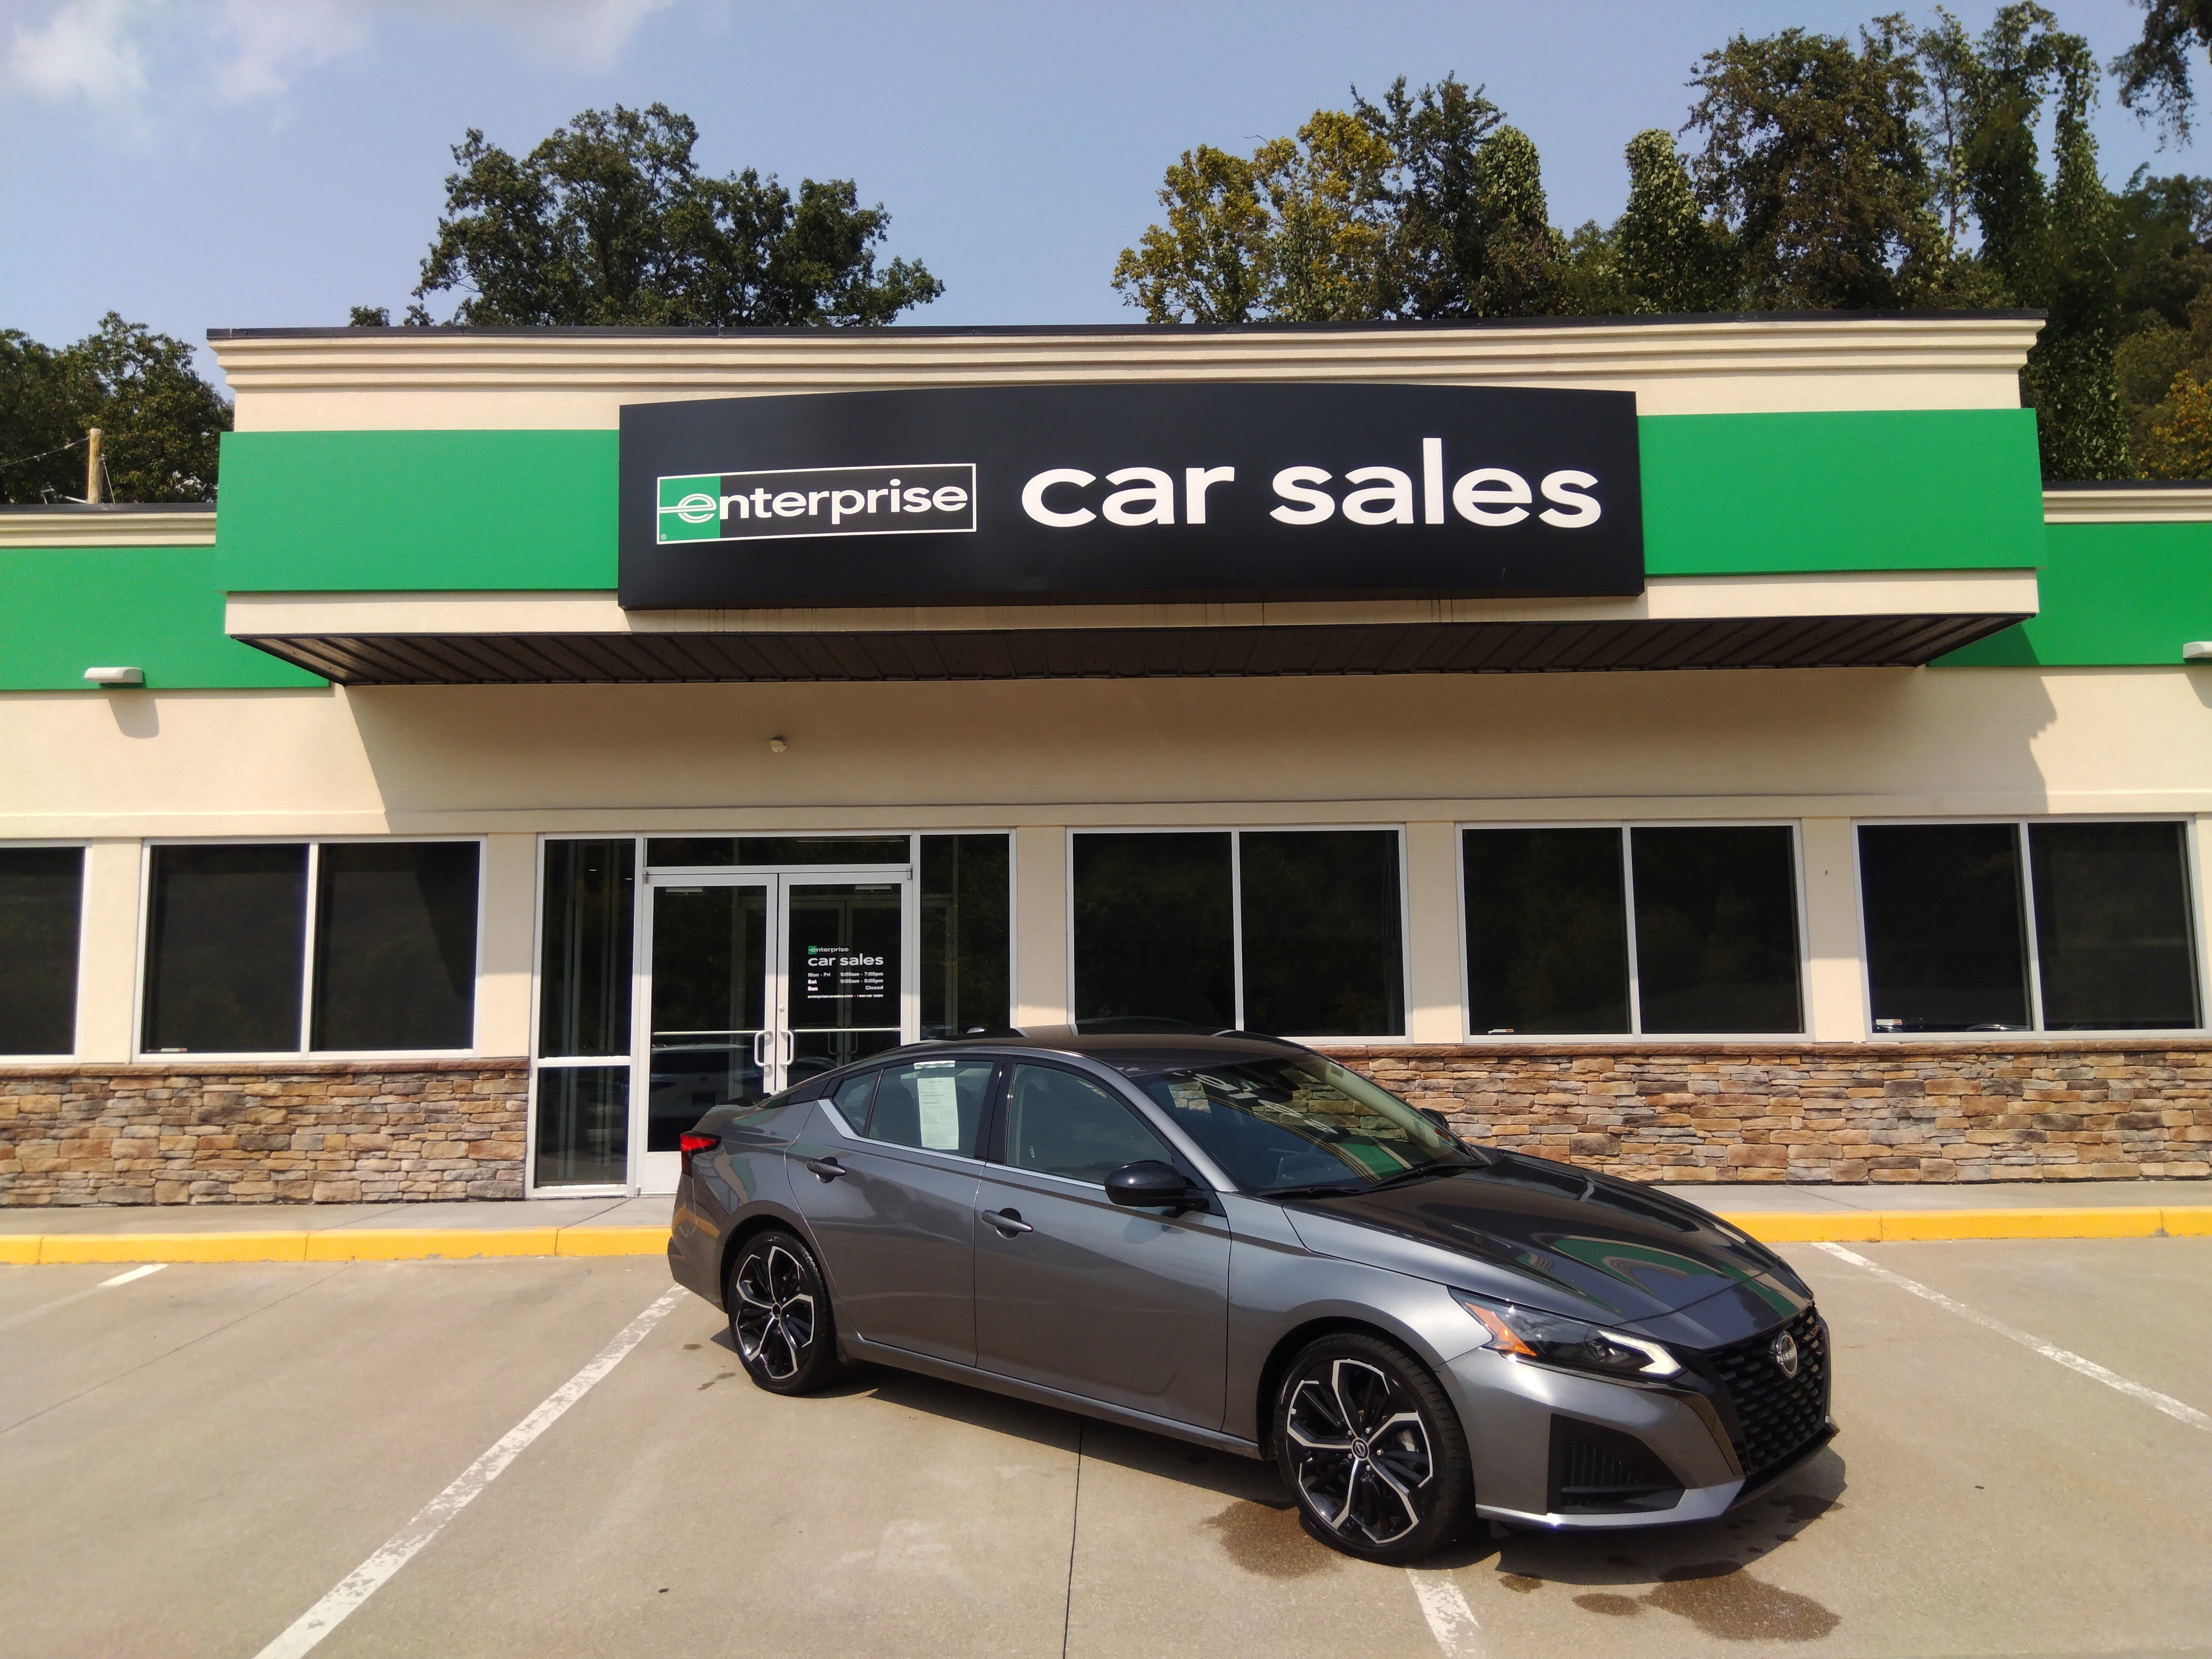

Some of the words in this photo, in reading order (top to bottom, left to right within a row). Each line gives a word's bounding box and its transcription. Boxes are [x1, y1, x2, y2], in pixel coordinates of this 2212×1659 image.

[676, 477, 969, 525] enterprise
[1021, 465, 1236, 528] car
[1268, 437, 1602, 529] sales
[808, 958, 836, 966] car
[840, 953, 884, 966] sales
